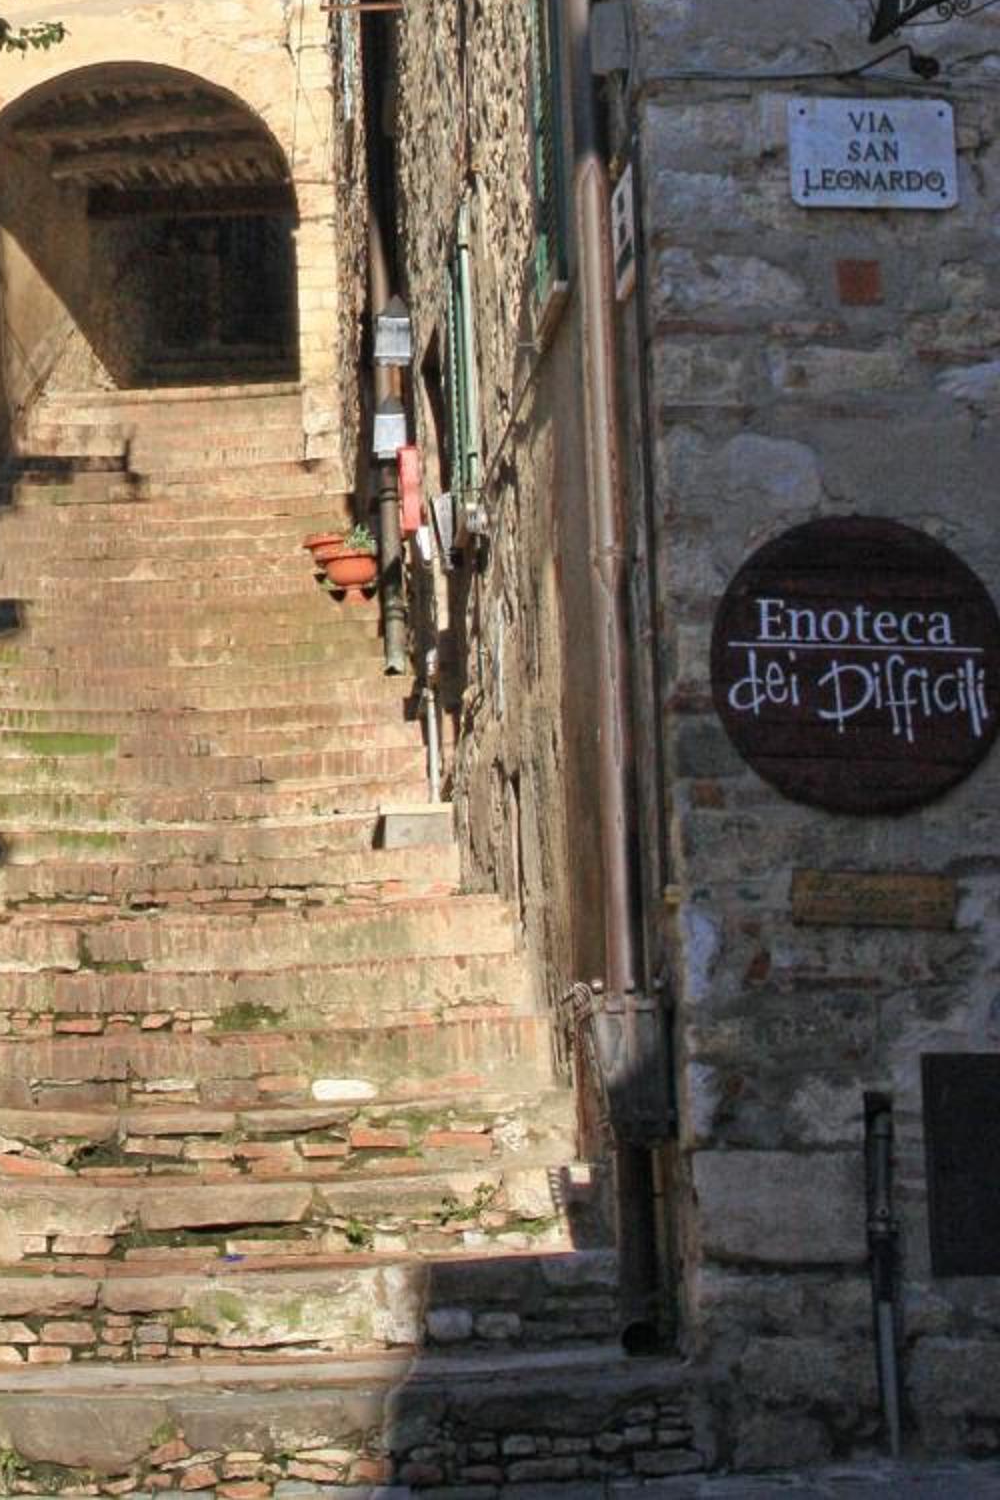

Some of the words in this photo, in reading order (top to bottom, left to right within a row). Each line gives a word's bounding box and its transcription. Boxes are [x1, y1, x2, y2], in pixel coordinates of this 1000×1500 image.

[847, 112, 895, 134] VIA
[847, 141, 900, 162] SAN
[803, 168, 946, 192] LEONARDO
[755, 598, 956, 645] Enoteca
[727, 649, 801, 715] dei
[817, 653, 990, 743] Difficili
